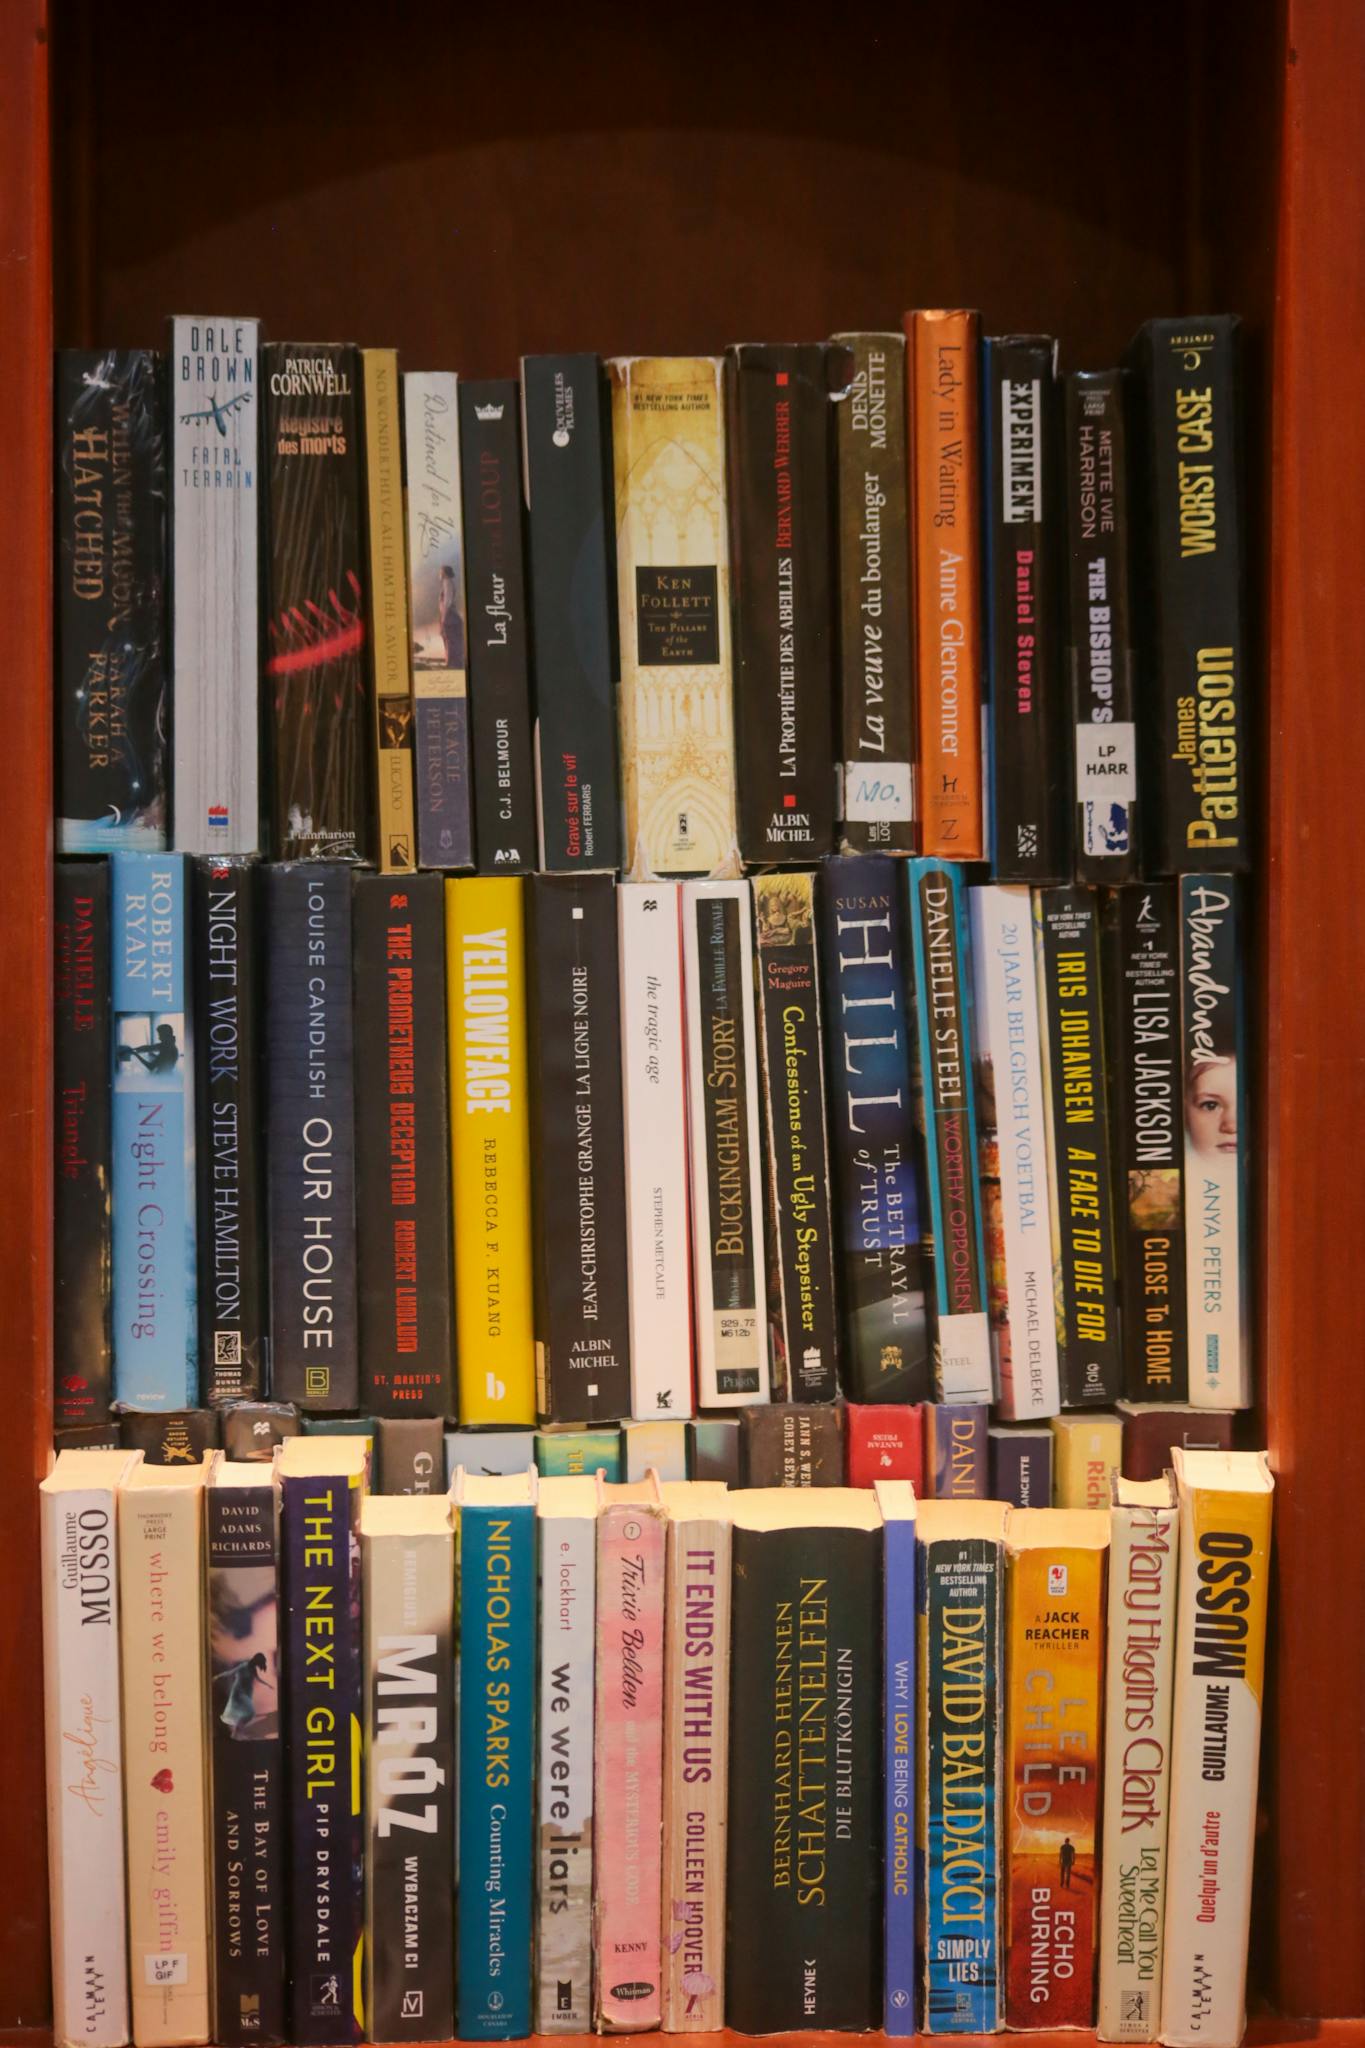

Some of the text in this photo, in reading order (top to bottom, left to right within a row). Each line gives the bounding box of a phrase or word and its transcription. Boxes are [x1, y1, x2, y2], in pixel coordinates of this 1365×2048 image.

[182, 356, 252, 383] BROWN
[191, 327, 243, 353] DALE
[870, 352, 885, 449] MONETTE
[931, 346, 962, 528] Lady in Waiting
[73, 427, 109, 600] HATCHED
[774, 400, 792, 548] BERNARD WERBER
[1079, 425, 1097, 538] HARRISON
[1099, 430, 1114, 533] METTE IVIE
[1176, 386, 1216, 558] WORST CASE
[485, 574, 512, 647] La fleur
[641, 594, 712, 608] FOLLETT
[657, 575, 692, 590] KEN
[1016, 550, 1035, 714] Daniel Steven
[939, 550, 965, 758] Anne Glenconner
[89, 652, 108, 769] PARKER
[426, 708, 444, 812] PETERSON
[443, 709, 461, 784] TRACIE
[496, 719, 511, 787] BELMOUR
[1098, 746, 1117, 757] LP
[1187, 647, 1238, 849] Patterson
[562, 753, 580, 856] Gravé sur le vif
[771, 814, 810, 826] ALBIN
[1087, 764, 1128, 776] HARR
[584, 828, 593, 857] Robert
[767, 828, 814, 842] MICHEL
[126, 894, 146, 981] RYAN
[151, 871, 172, 1003] ROBERT
[835, 896, 890, 910] SUSAN
[208, 890, 238, 1084] NIGHT WORK
[463, 928, 512, 1114] YELLOWFACE
[768, 977, 811, 990] Maguire
[837, 912, 901, 1133] HILL
[925, 887, 961, 1103] DANIELLE STEEL
[1056, 952, 1087, 998] IRIS
[1125, 969, 1175, 977] BESTSELLING
[1187, 886, 1230, 1066] Abandoned
[387, 923, 416, 1205] THE PROMETHEUS DECEPTION
[573, 967, 591, 1094] LA LIGNE NOIRE
[646, 976, 662, 1084] the tragic age
[708, 1015, 737, 1088] STORY
[1060, 1009, 1094, 1123] JOHANSEN
[1133, 992, 1172, 1162] LISA JACKSON
[714, 1097, 744, 1256] BUCKINGHAM
[783, 1006, 819, 1331] Confessions of an Ugly Stepsister
[1067, 1147, 1096, 1160] A
[1069, 1169, 1099, 1219] FACE
[212, 1102, 240, 1320] STEVE HAMILTON
[484, 1138, 500, 1335] REBECCA F. KUANG
[653, 1187, 665, 1300] STEPHEN METCALFE
[883, 1143, 908, 1324] The BETRAYAL
[1072, 1227, 1101, 1252] TO
[1203, 1179, 1221, 1238] ANYA
[395, 1219, 418, 1352] ROBERT LUDLUM
[1073, 1259, 1103, 1294] DIE
[1076, 1301, 1105, 1341] FOR
[1204, 1247, 1222, 1313] PETERS
[569, 1354, 618, 1368] MICHEL
[572, 1338, 611, 1351] ALBIN
[1025, 1271, 1043, 1405] MICHAEL DELBEKE
[61, 1512, 79, 1590] Guillaume
[211, 1541, 271, 1551] RICHARDS
[220, 1524, 261, 1534] ADAMS
[222, 1507, 259, 1516] DAVID
[78, 1508, 111, 1627] MUSSO
[559, 1542, 576, 1632] e. lockhart
[935, 1563, 995, 1574] NEW YORK TIMES
[949, 1588, 978, 1598] AUTHOR
[1044, 1612, 1080, 1624] JACK
[1193, 1532, 1253, 1679] MUSSO
[149, 1552, 172, 1753] where we belong
[304, 1490, 336, 1799] THE NEXT GIRL
[486, 1519, 512, 1788] NICHOLAS SPARKS
[683, 1550, 715, 1783] IT ENDS WITH US
[894, 1660, 908, 1700] WHY
[1025, 1628, 1090, 1641] REACHER
[1033, 1642, 1080, 1651] THRILLER
[377, 1634, 445, 1838] MRÓZ
[797, 1577, 828, 1906] SCHATTENELFEN
[894, 1713, 908, 1755] LOVE
[894, 1759, 909, 1808] BEING
[942, 1605, 986, 1926] DAVID BALDACCI
[1023, 1668, 1055, 1818] CHILD
[549, 1662, 582, 1915] we were liars
[316, 1804, 330, 1962] PIP DRYSDALE
[485, 1804, 507, 1977] Counting Miracles
[894, 1813, 908, 1897] CATHOLIC
[405, 1855, 418, 1969] WYBACZAM CI
[614, 1941, 647, 1953] KENNY
[1030, 1888, 1051, 2005] BURNING
